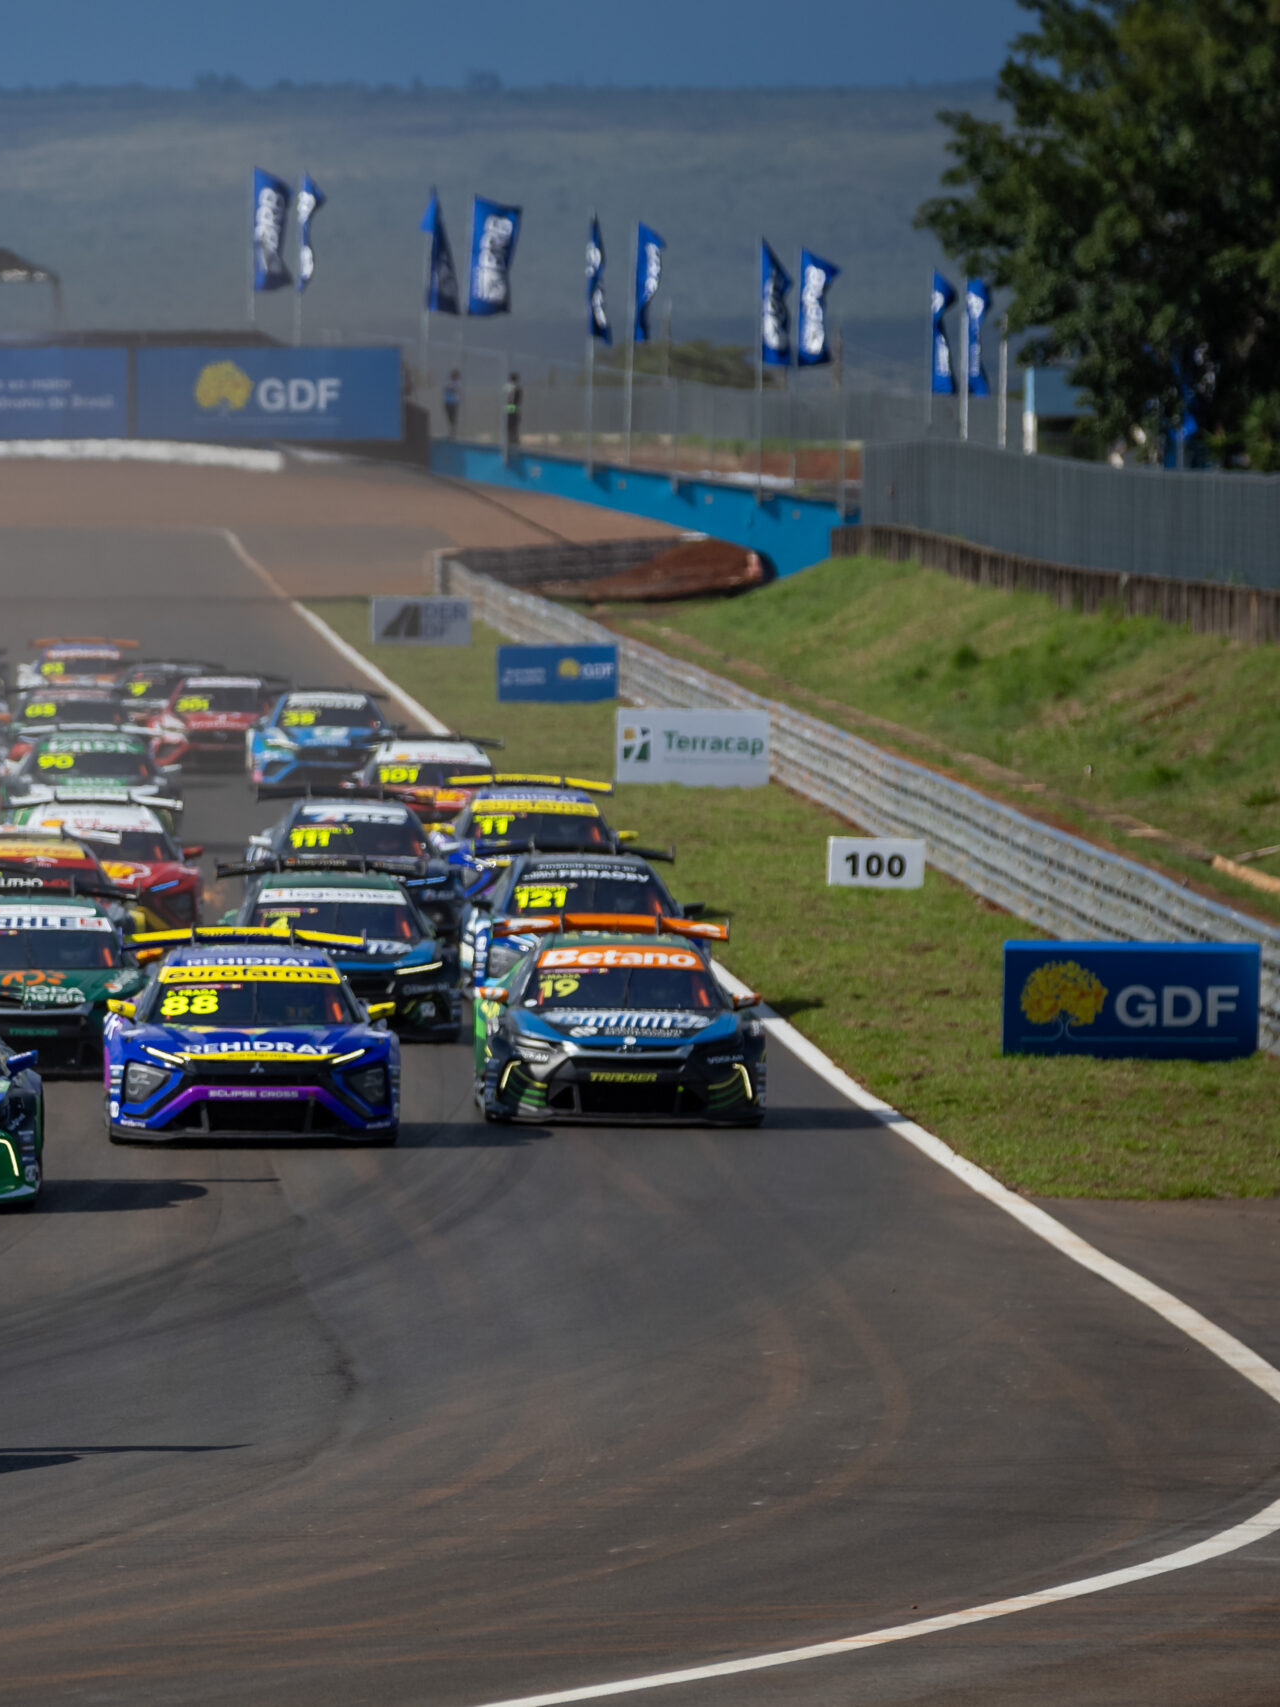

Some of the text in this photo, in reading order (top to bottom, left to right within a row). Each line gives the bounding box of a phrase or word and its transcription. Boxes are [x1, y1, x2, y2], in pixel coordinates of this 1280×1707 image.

[257, 377, 341, 412] GDF
[662, 730, 765, 755] Terracap
[38, 755, 74, 770] 90
[379, 767, 419, 784] 101
[480, 817, 509, 835] 11
[290, 831, 331, 848] 111
[845, 852, 907, 879] 100
[514, 888, 567, 909] 121
[186, 957, 314, 967] REHIDRAT
[541, 949, 697, 967] Betano
[168, 966, 333, 980] eurofarma
[540, 979, 580, 998] 19
[160, 994, 219, 1016] 88
[1114, 985, 1240, 1028] GDF
[184, 1041, 334, 1055] REHIDRAT
[590, 1071, 658, 1083] TRACKER
[208, 1089, 299, 1098] ECLIPSE CROSS
